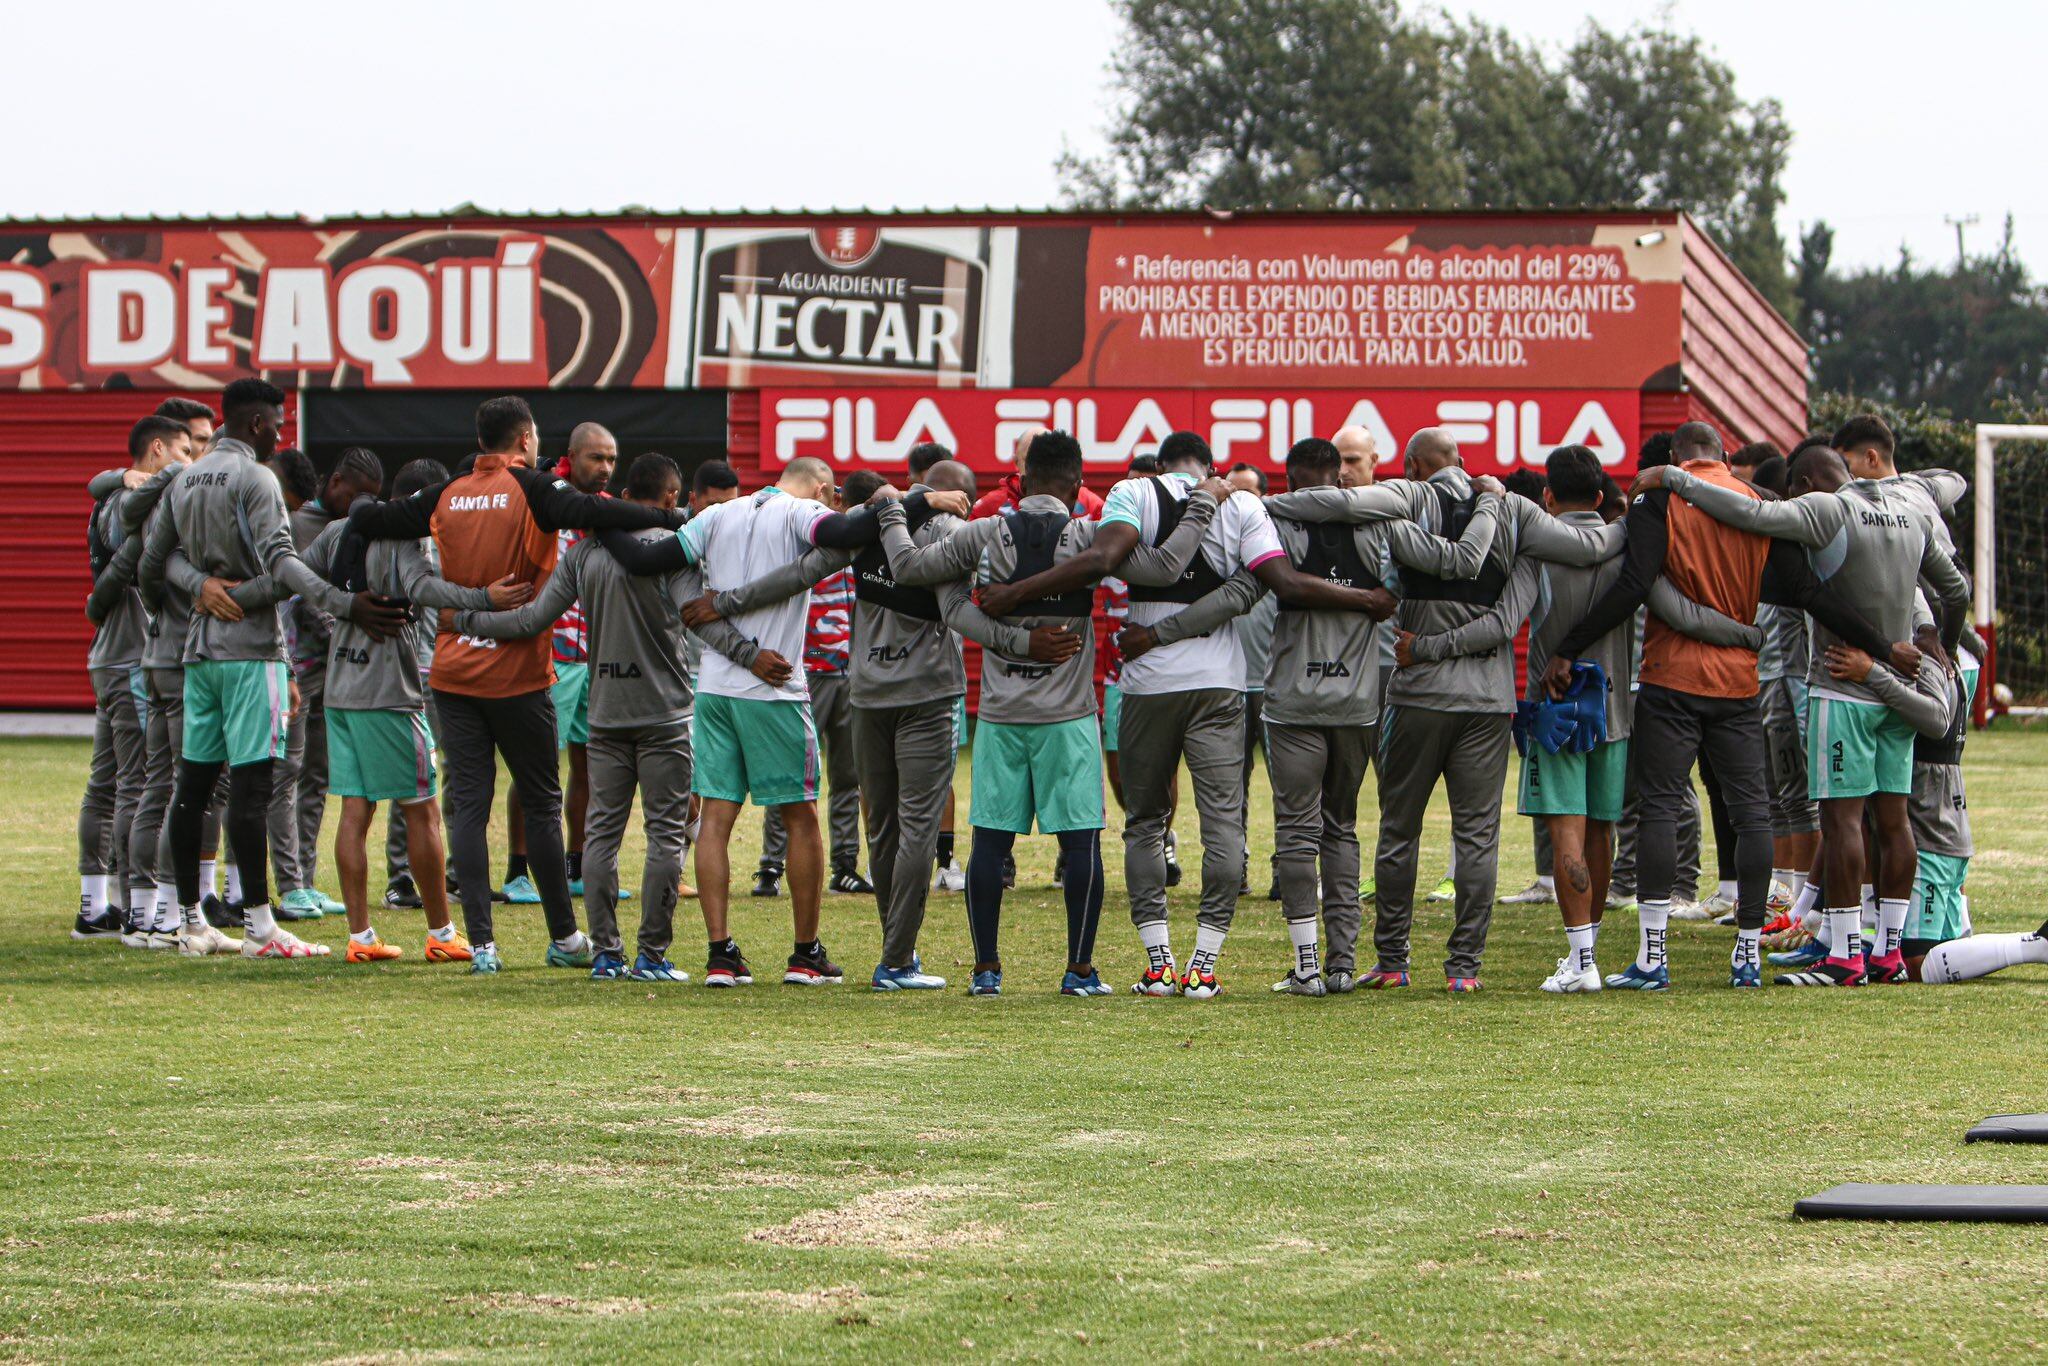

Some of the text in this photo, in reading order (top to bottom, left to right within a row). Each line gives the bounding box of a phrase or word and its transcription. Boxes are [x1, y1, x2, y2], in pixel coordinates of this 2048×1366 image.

[1133, 254, 1621, 281] Referencia con Volumen de alcohol del 29%
[778, 271, 907, 297] AGUARDIENTE
[1100, 285, 1636, 313] PROHIBASE EL EXPENDIO DE BEBIDAS EMBRIAGANTES
[86, 268, 231, 366] DE
[256, 241, 539, 384] AQUÍ
[1140, 312, 1593, 339] A MENORES DE EDAD. EL EXCESO DE ALCOHOL
[714, 292, 962, 365] NECTAR
[1203, 339, 1528, 367] ES PERJUDICIAL PARA LA SALUD.
[775, 397, 958, 462] FILA
[995, 397, 1175, 462] FILA
[1436, 399, 1627, 466] FILA
[184, 472, 229, 489] SANTA FE
[449, 493, 508, 510] SANTA FE
[1861, 511, 1909, 528] SANTA FE
[862, 571, 896, 588] CATAPULT
[334, 647, 370, 665] FILA
[868, 645, 910, 663] FILA
[598, 662, 642, 679] FILA
[1006, 662, 1053, 679] FILA
[1306, 661, 1350, 678] FILA
[1832, 740, 1844, 773] FILA
[1529, 753, 1540, 787] FILA
[1924, 883, 1936, 915] FILA
